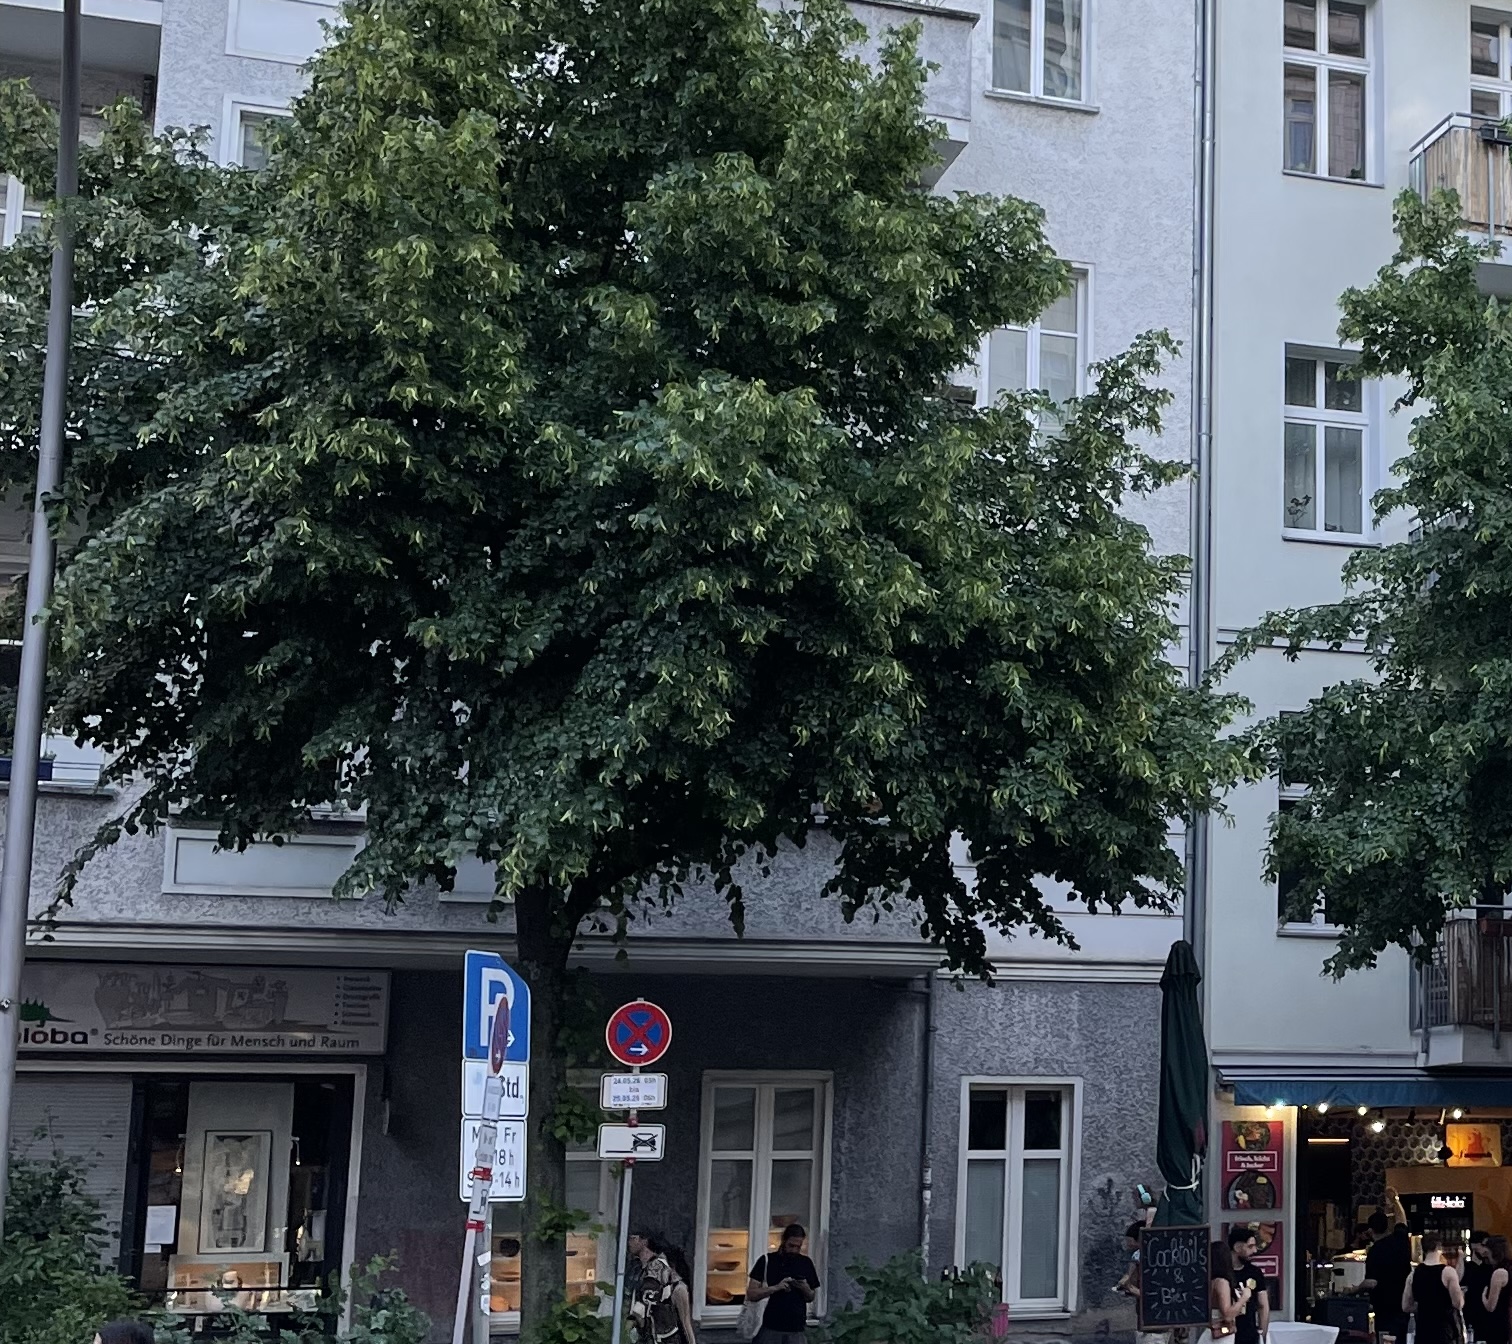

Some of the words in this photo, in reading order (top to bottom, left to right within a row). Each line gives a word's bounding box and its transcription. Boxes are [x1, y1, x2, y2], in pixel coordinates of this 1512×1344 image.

[17, 1027, 89, 1045] loba
[104, 1032, 155, 1047] Schöne
[161, 1033, 203, 1049] Dinge
[207, 1033, 228, 1047] für
[231, 1033, 285, 1048] Mensch
[289, 1034, 316, 1049] und
[321, 1036, 360, 1048] Raum
[504, 1127, 517, 1143] Fr
[1147, 1235, 1208, 1267] Cocktails
[1173, 1267, 1185, 1284] &
